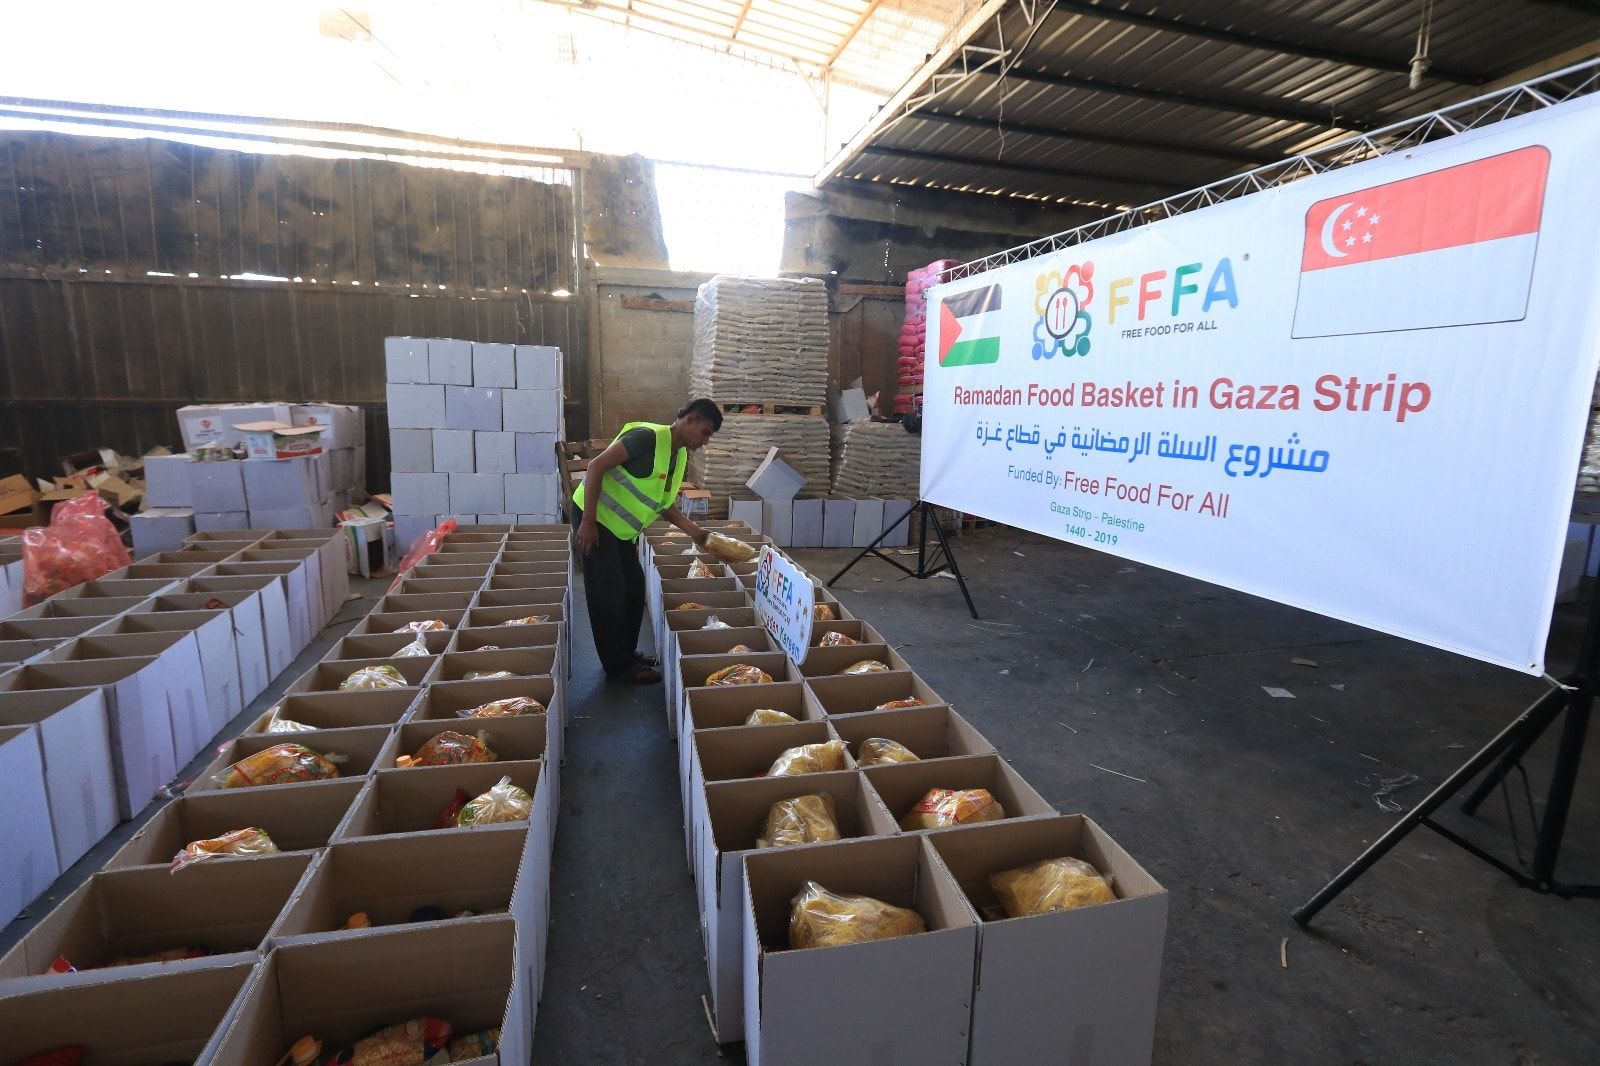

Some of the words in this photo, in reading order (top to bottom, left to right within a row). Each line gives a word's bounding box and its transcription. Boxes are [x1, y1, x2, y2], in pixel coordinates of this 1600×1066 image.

[1108, 256, 1240, 325] FFFA
[1121, 327, 1143, 340] FREE
[1144, 324, 1172, 337] FOOD
[1173, 322, 1195, 334] FOR
[1196, 319, 1218, 331] ALL
[953, 385, 1022, 406] Ramadan
[1027, 383, 1076, 407] Food
[1081, 381, 1165, 409] Basket
[1172, 379, 1199, 409] in
[1209, 377, 1300, 410] Gaza
[1313, 373, 1432, 423] Strip
[1005, 423, 1041, 452] قطاع
[1044, 426, 1067, 461] في
[1071, 426, 1152, 464] الرمضانية
[1157, 430, 1218, 463] السلة
[1223, 431, 1331, 479] مشروع
[1007, 464, 1044, 485] Funded
[1045, 470, 1062, 491] By:
[1063, 470, 1100, 496] Free
[1104, 476, 1152, 506] Food
[1157, 484, 1195, 512] For
[1197, 491, 1231, 519] All
[1050, 501, 1072, 517] Gaza
[1072, 506, 1093, 524] Strip
[1100, 511, 1146, 534] Palestine
[1065, 523, 1087, 539] 1440
[1093, 530, 1119, 547] 2019
